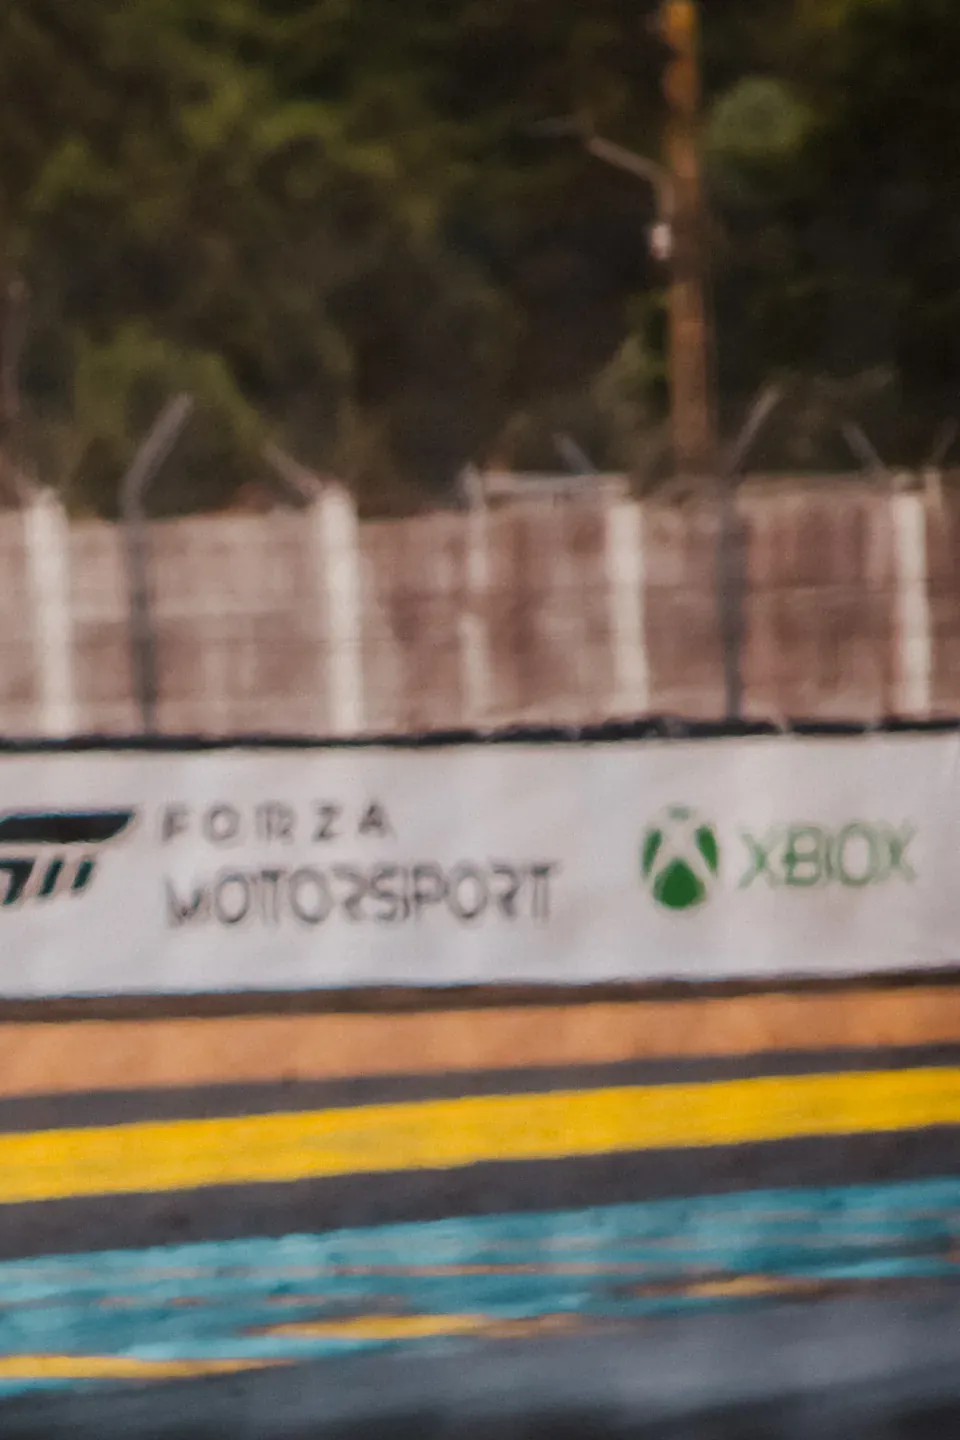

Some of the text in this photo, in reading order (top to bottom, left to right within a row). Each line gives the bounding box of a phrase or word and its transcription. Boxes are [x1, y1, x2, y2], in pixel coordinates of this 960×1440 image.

[162, 801, 390, 844] FORZA
[740, 821, 916, 890] XBOX
[164, 862, 560, 926] MOTORSPORT
